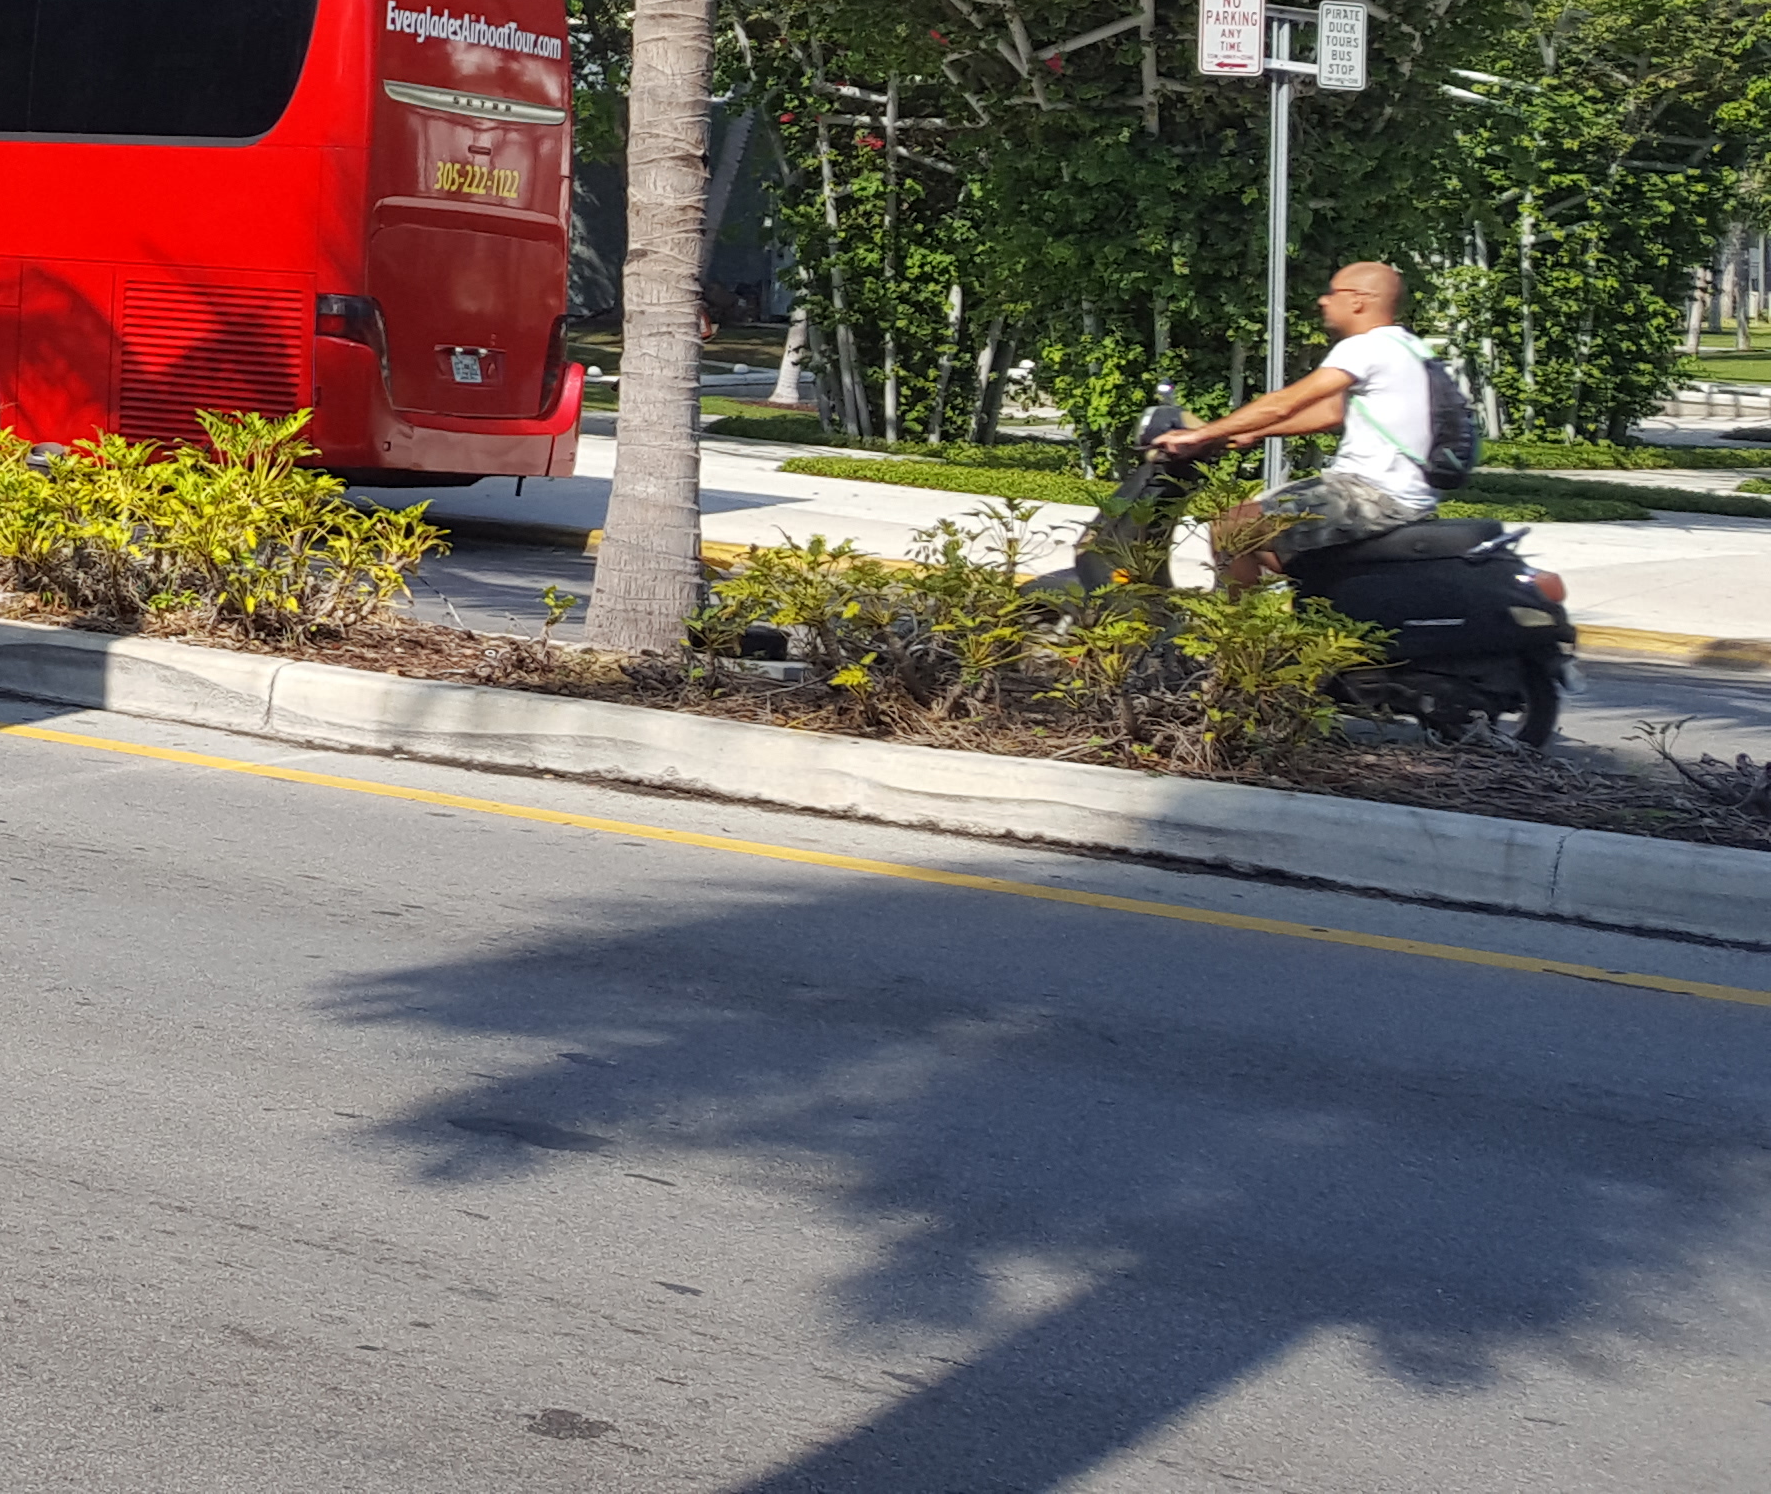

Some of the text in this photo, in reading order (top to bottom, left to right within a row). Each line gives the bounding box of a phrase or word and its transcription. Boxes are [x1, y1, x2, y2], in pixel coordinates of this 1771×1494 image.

[1205, 10, 1258, 26] PARKING
[1325, 8, 1361, 22] PIRATE
[386, 0, 562, 60] EvergladesAirboatTour.com
[1220, 29, 1242, 39] ANY
[1328, 22, 1356, 35] DUCK
[1220, 41, 1242, 52] TIME
[1325, 35, 1359, 48] TOURS
[1331, 49, 1352, 62] BUS
[1328, 63, 1355, 76] STOP
[434, 161, 520, 199] 305-222-1122
